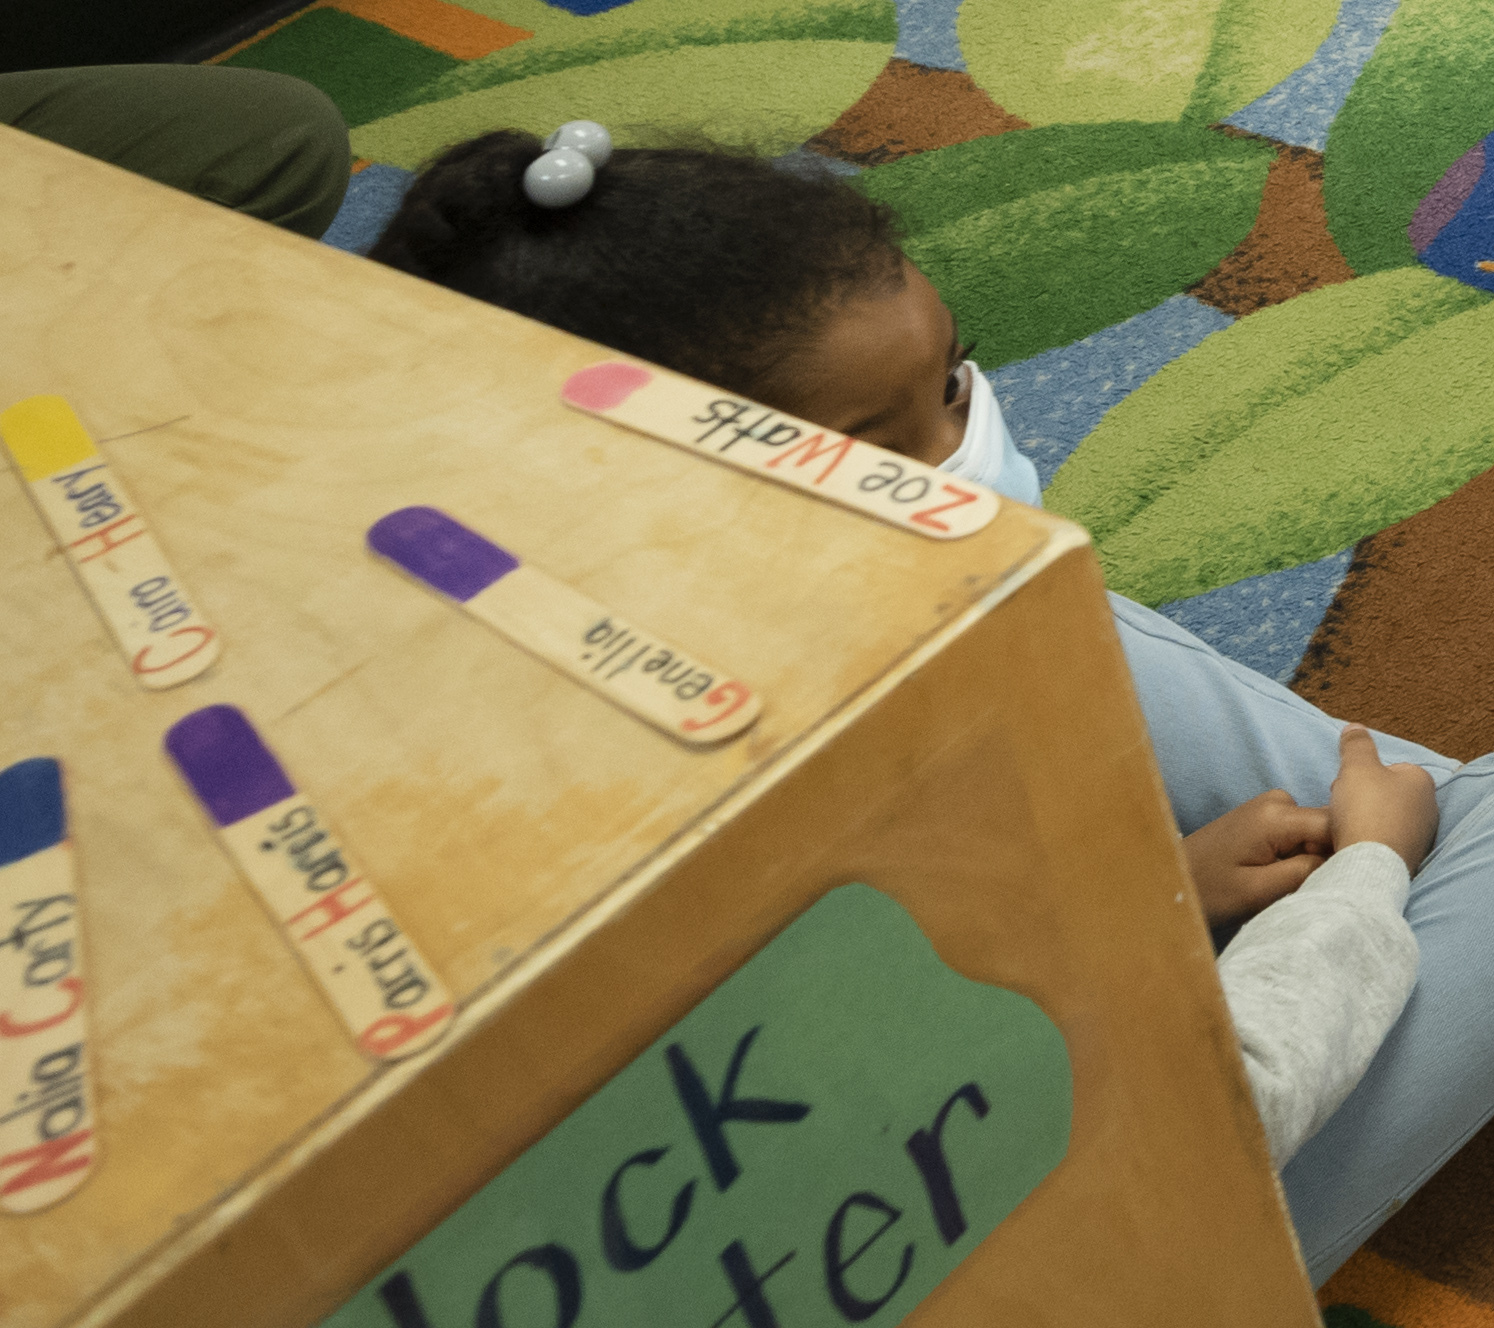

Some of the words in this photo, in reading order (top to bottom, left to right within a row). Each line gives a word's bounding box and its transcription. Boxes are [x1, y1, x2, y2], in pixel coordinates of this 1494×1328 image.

[692, 399, 856, 486] Watts
[859, 460, 978, 532] Zoe
[129, 575, 215, 674] Cairo
[582, 618, 750, 732] Genellia
[259, 806, 373, 942] Harris
[334, 917, 455, 1057] Parris
